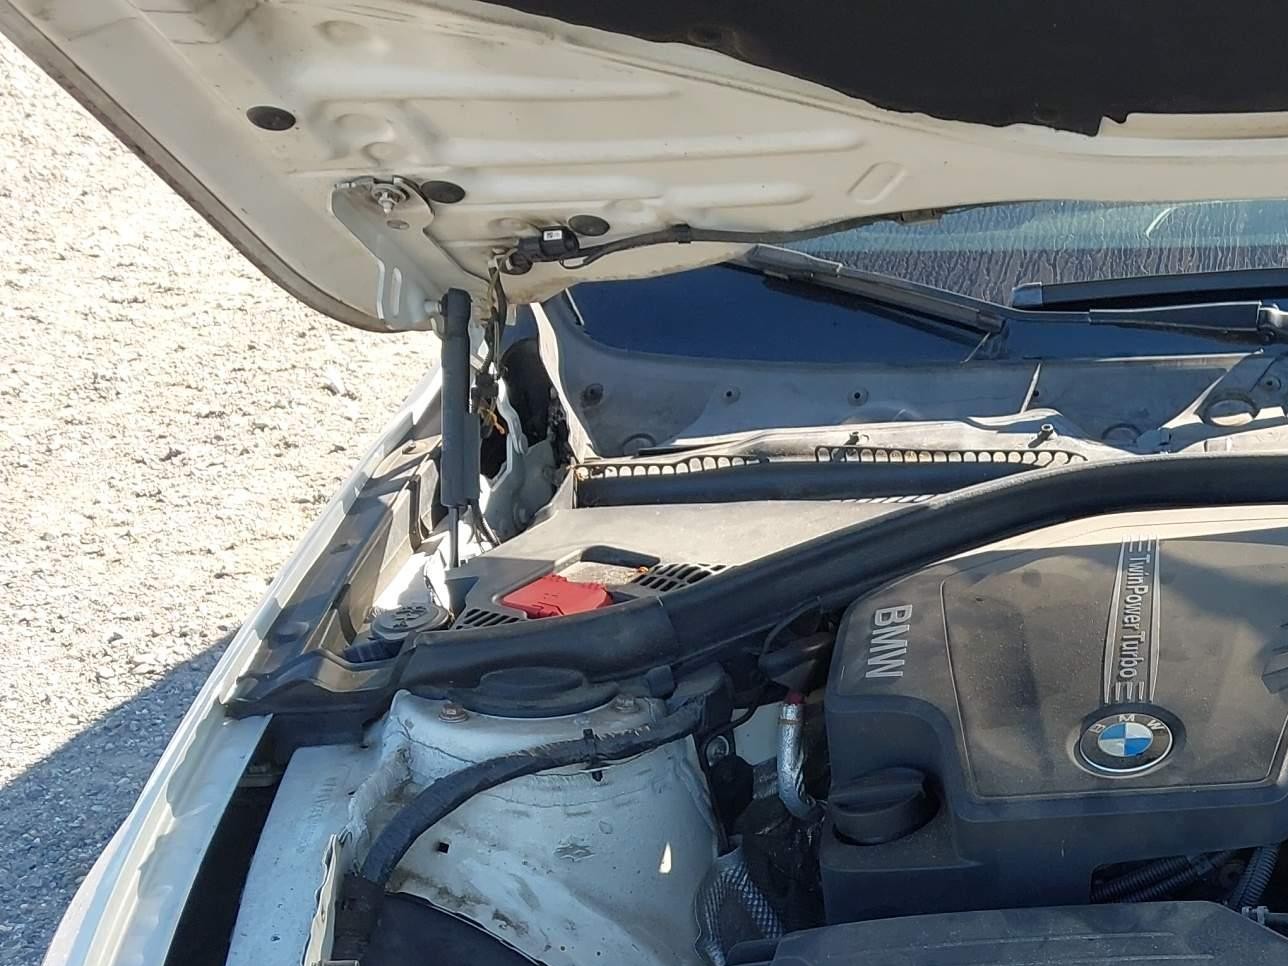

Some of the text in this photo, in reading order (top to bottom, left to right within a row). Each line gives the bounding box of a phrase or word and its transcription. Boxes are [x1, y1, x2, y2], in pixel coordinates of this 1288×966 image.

[865, 604, 913, 679] BMW
[1119, 554, 1151, 678] TwinPower Turbo
[1088, 713, 1167, 734] BMW
